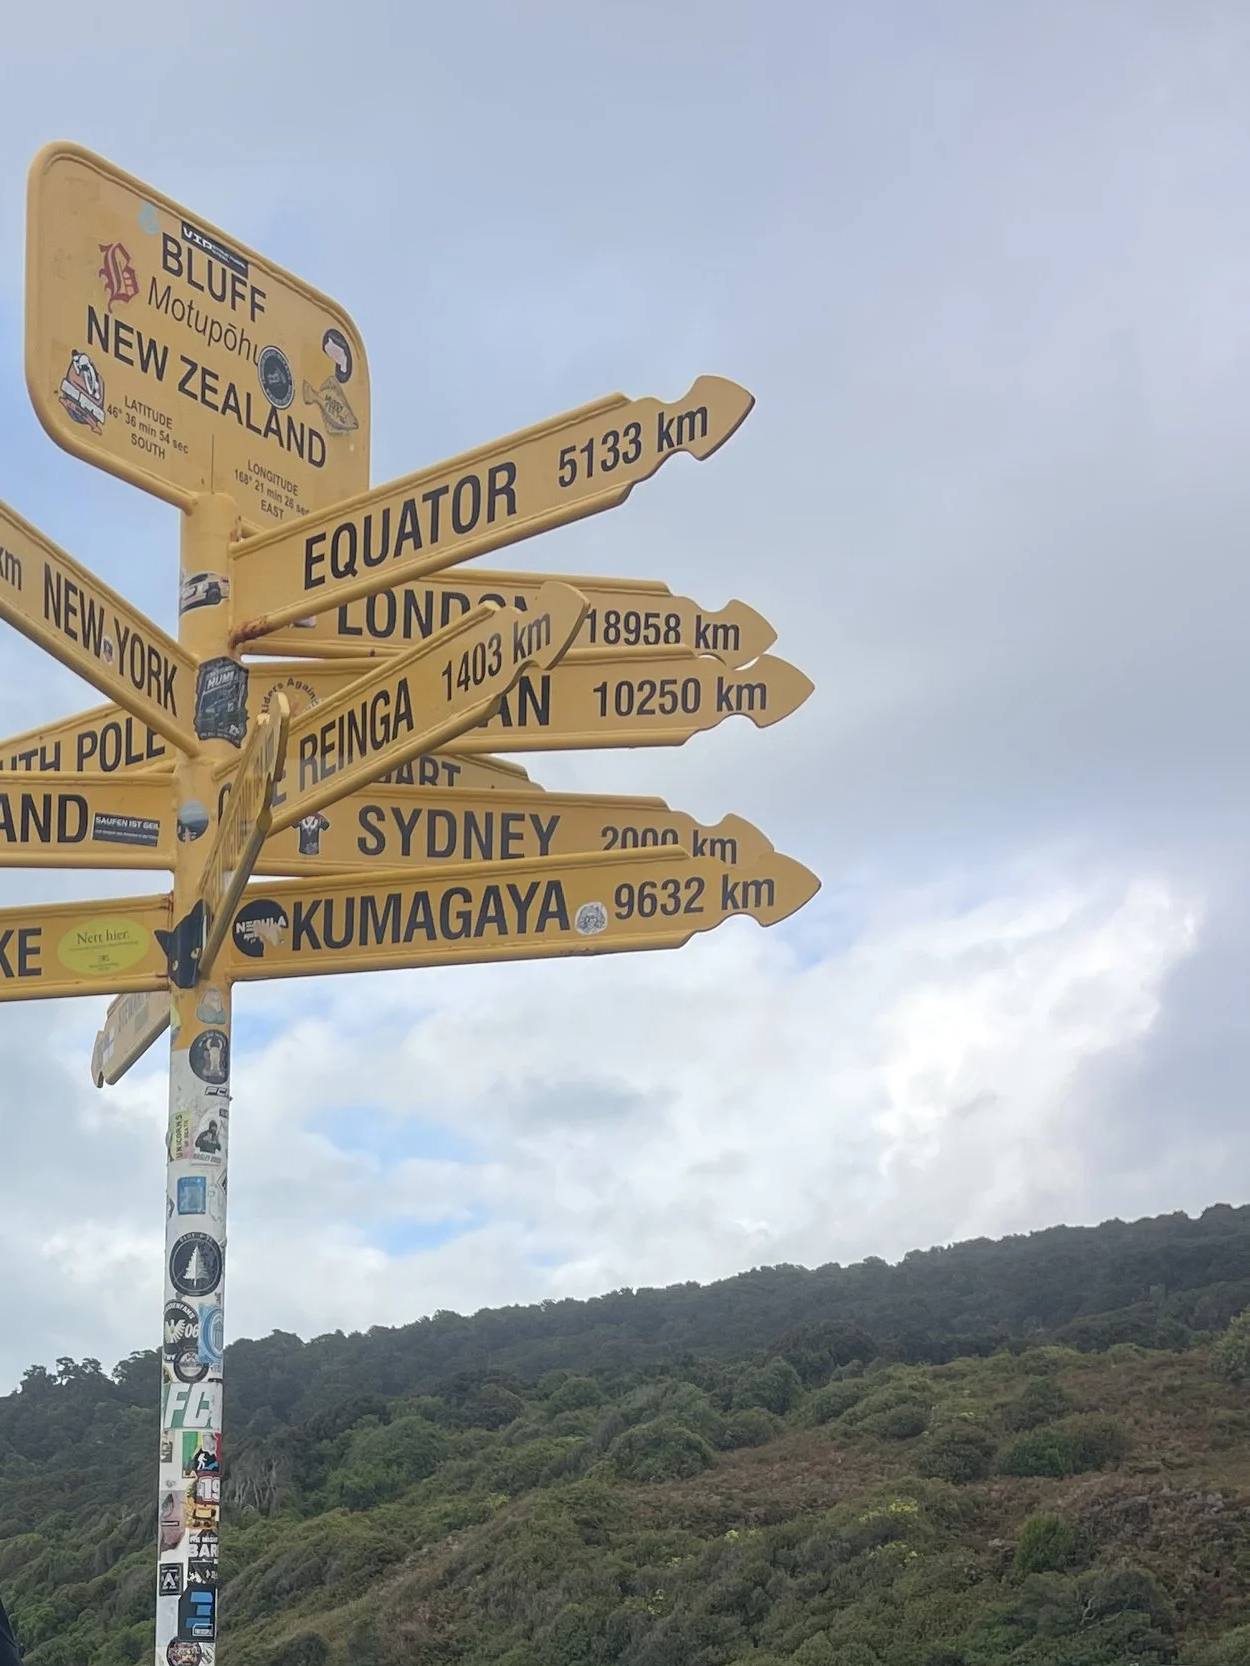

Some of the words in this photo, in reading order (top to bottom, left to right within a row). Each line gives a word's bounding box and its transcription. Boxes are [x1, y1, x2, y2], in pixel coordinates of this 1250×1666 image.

[162, 232, 267, 323] BLUFF
[87, 305, 168, 382] NEW
[178, 355, 327, 469] ZEALAND
[124, 395, 173, 431] LATITUDE
[125, 412, 137, 428] 36
[138, 421, 157, 438] min
[159, 430, 170, 445] 54
[172, 438, 189, 455] sec
[130, 432, 166, 460] SOUTH
[248, 460, 299, 497] LONGITUDE
[254, 479, 264, 493] 21
[266, 487, 283, 504] min
[304, 461, 518, 591] EQUATOR
[557, 422, 643, 488] 5133
[656, 404, 709, 453] km
[261, 500, 285, 521] EAST
[43, 561, 106, 656] NEW
[112, 622, 179, 717] YORK
[337, 588, 529, 640] LOND
[585, 607, 682, 645] 18958
[695, 614, 741, 651] km
[298, 676, 415, 792] REINGA
[442, 632, 502, 702] 1403
[513, 612, 551, 664] km
[592, 677, 701, 717] 10250
[716, 675, 768, 712] km
[76, 717, 166, 773] POLE
[357, 804, 561, 860] SYDNEY
[692, 829, 737, 865] km
[292, 879, 571, 952] KUMAGAYA
[614, 876, 705, 921] 9632
[722, 874, 775, 911] km
